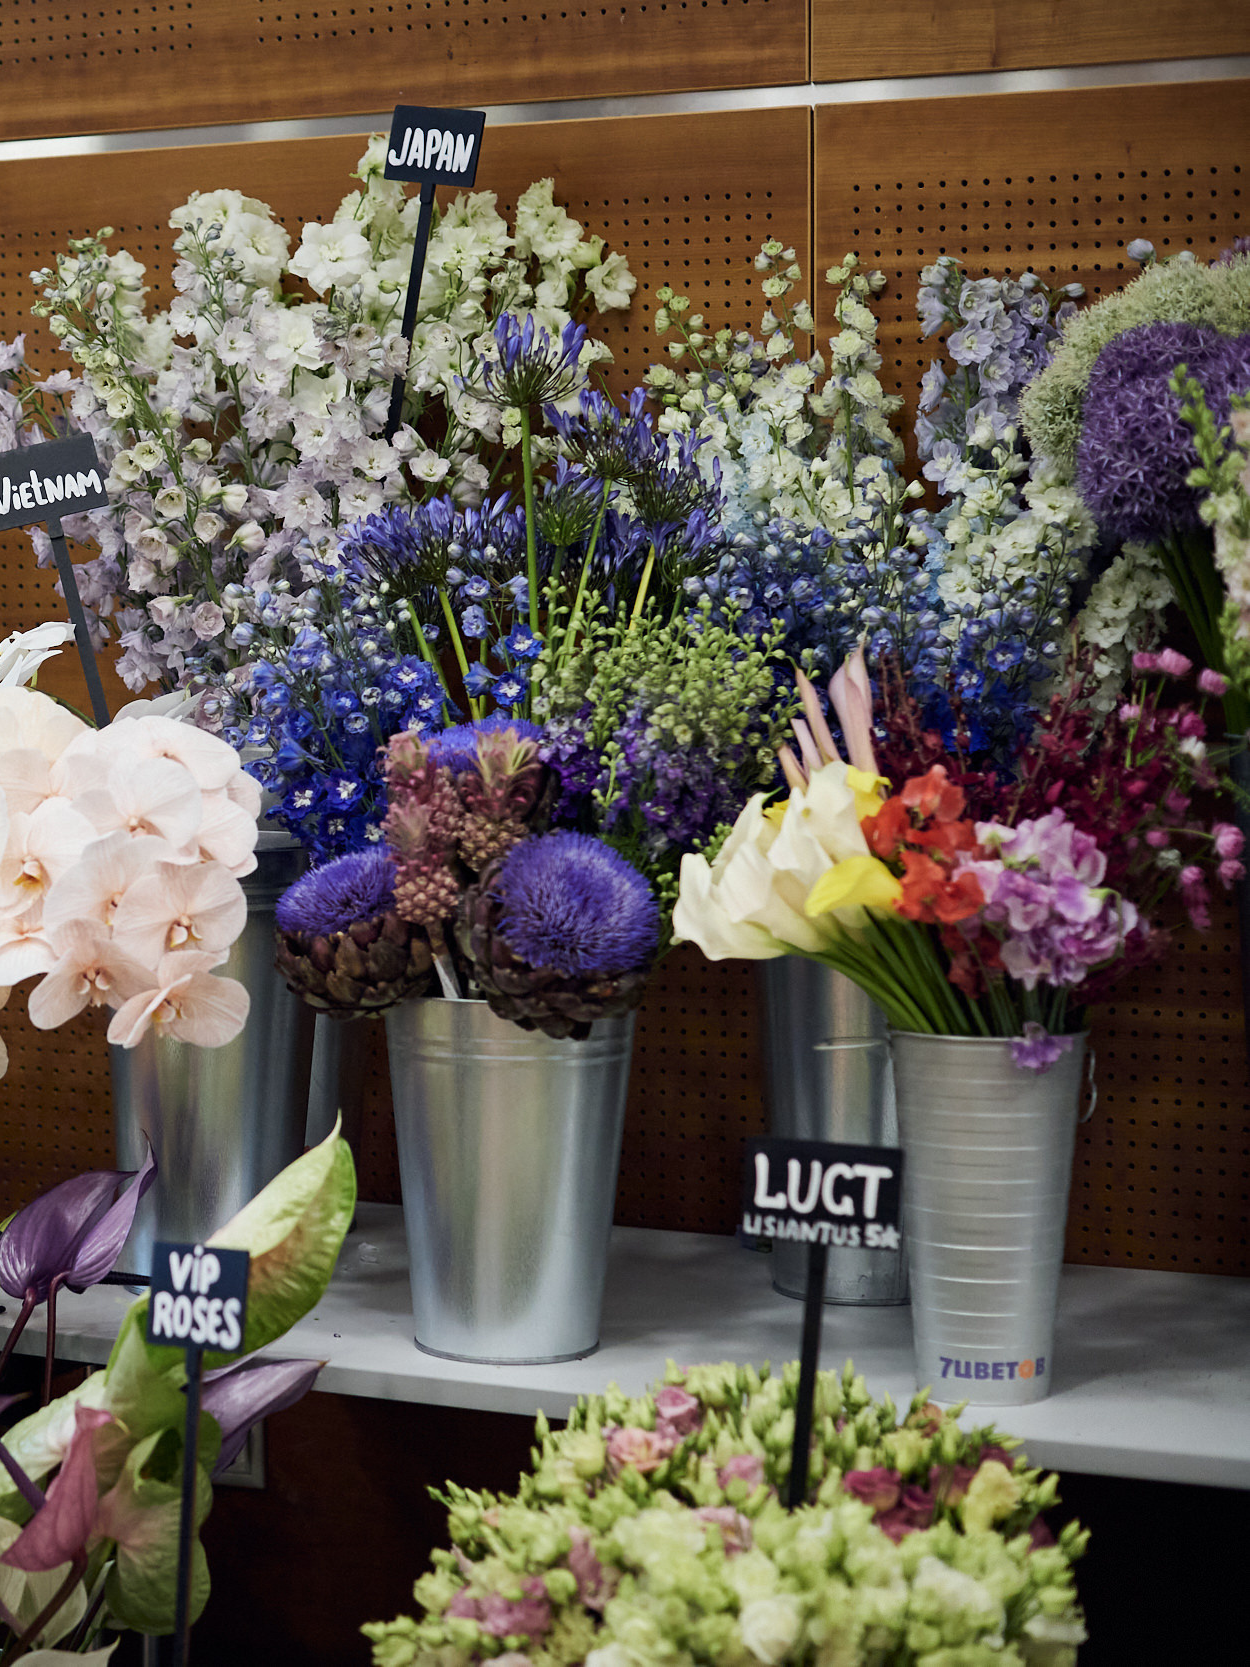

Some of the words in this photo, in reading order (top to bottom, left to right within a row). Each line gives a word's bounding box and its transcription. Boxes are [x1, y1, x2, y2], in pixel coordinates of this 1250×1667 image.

[388, 127, 475, 173] JAPAN
[754, 1152, 893, 1219] LUGT
[742, 1211, 861, 1248] LISIANTUS
[152, 1290, 242, 1350] ROSES
